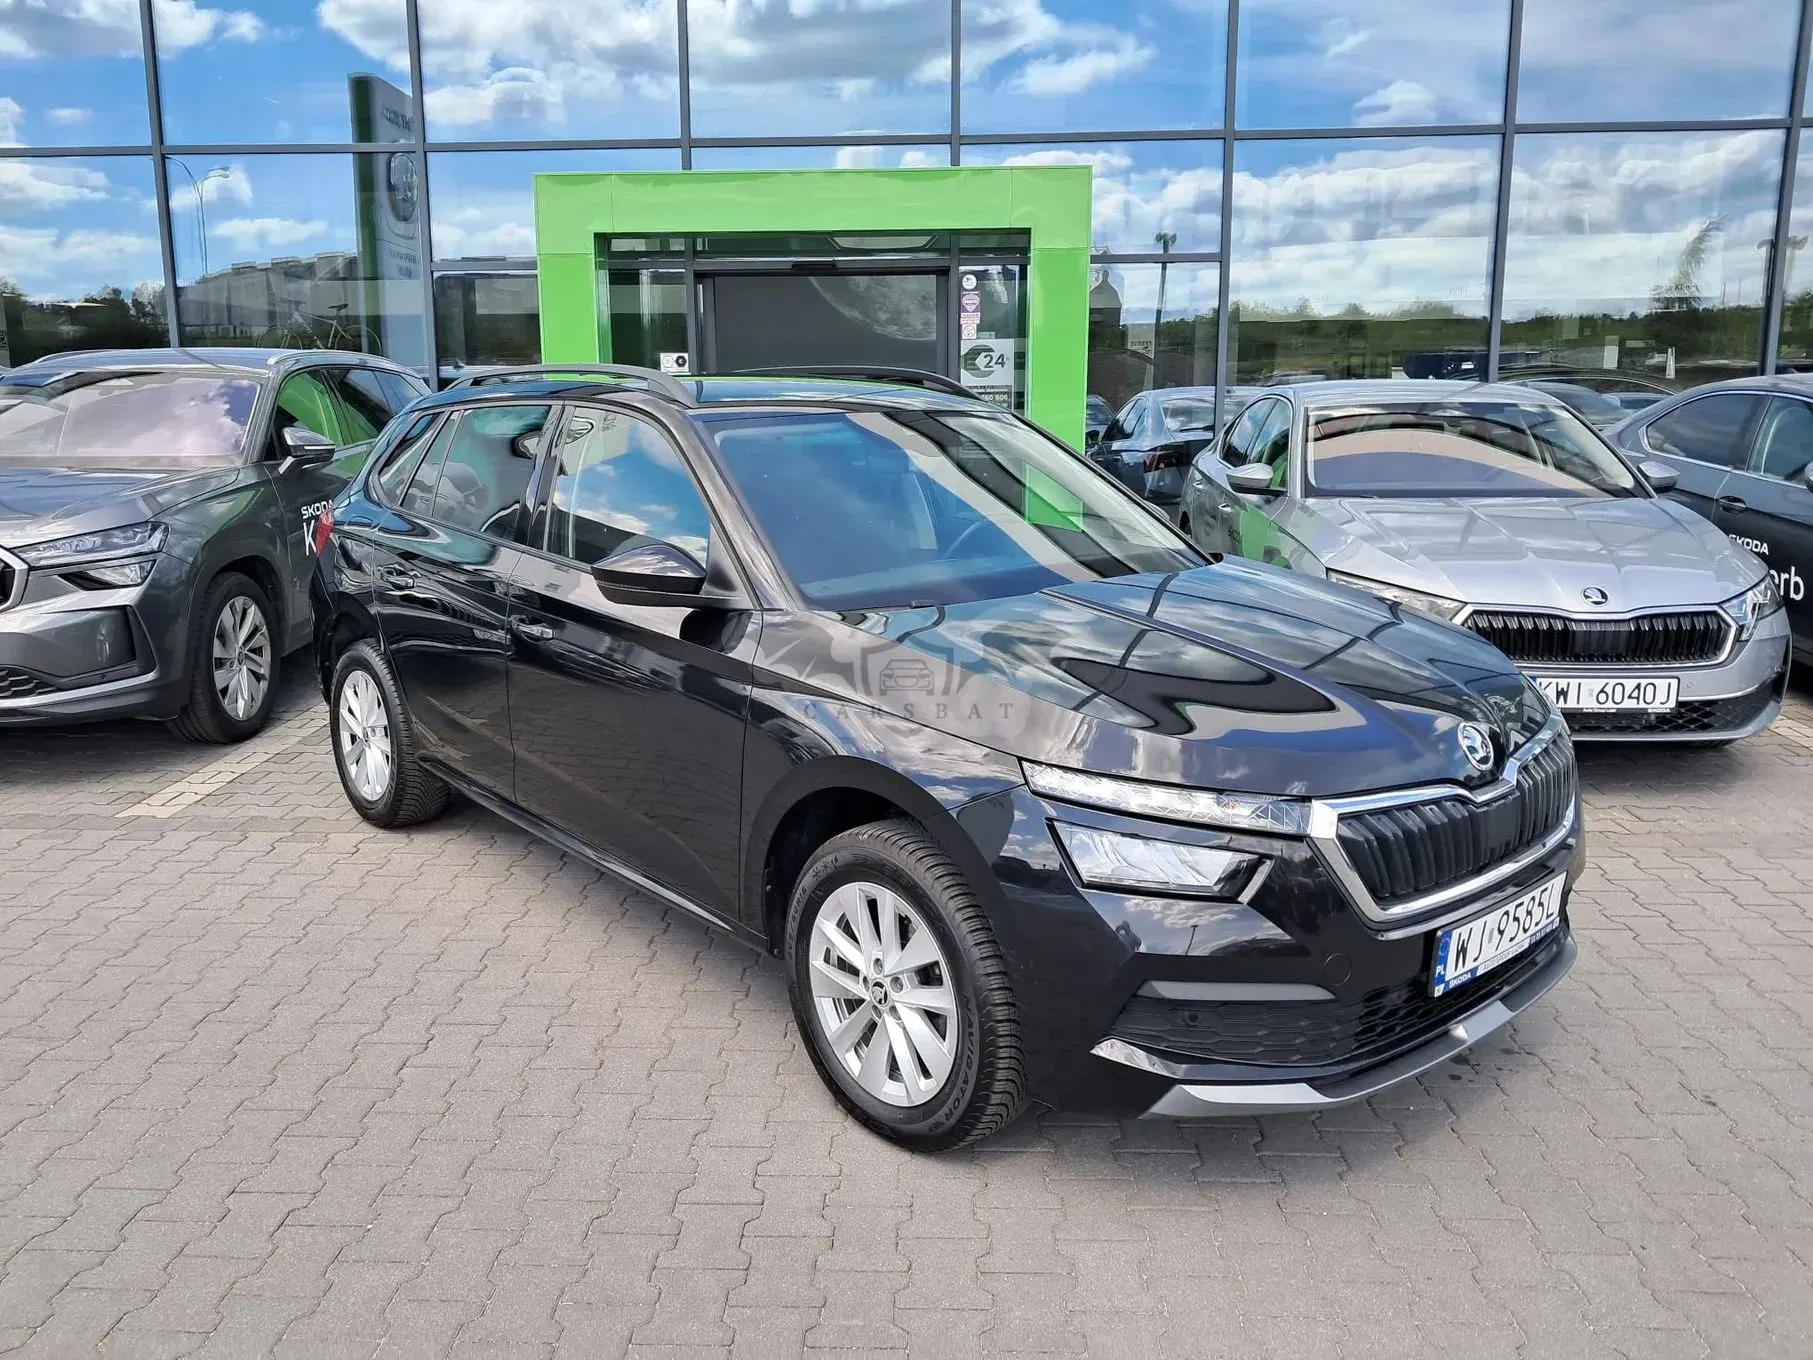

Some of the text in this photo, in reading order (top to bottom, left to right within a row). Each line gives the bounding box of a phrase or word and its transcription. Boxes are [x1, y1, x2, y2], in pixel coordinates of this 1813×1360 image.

[1596, 682, 1672, 705] 6040J
[1454, 919, 1488, 973] WJ
[1495, 882, 1556, 952] 9585L
[1436, 964, 1446, 977] PL
[944, 994, 975, 1121] NAVIGATOR
